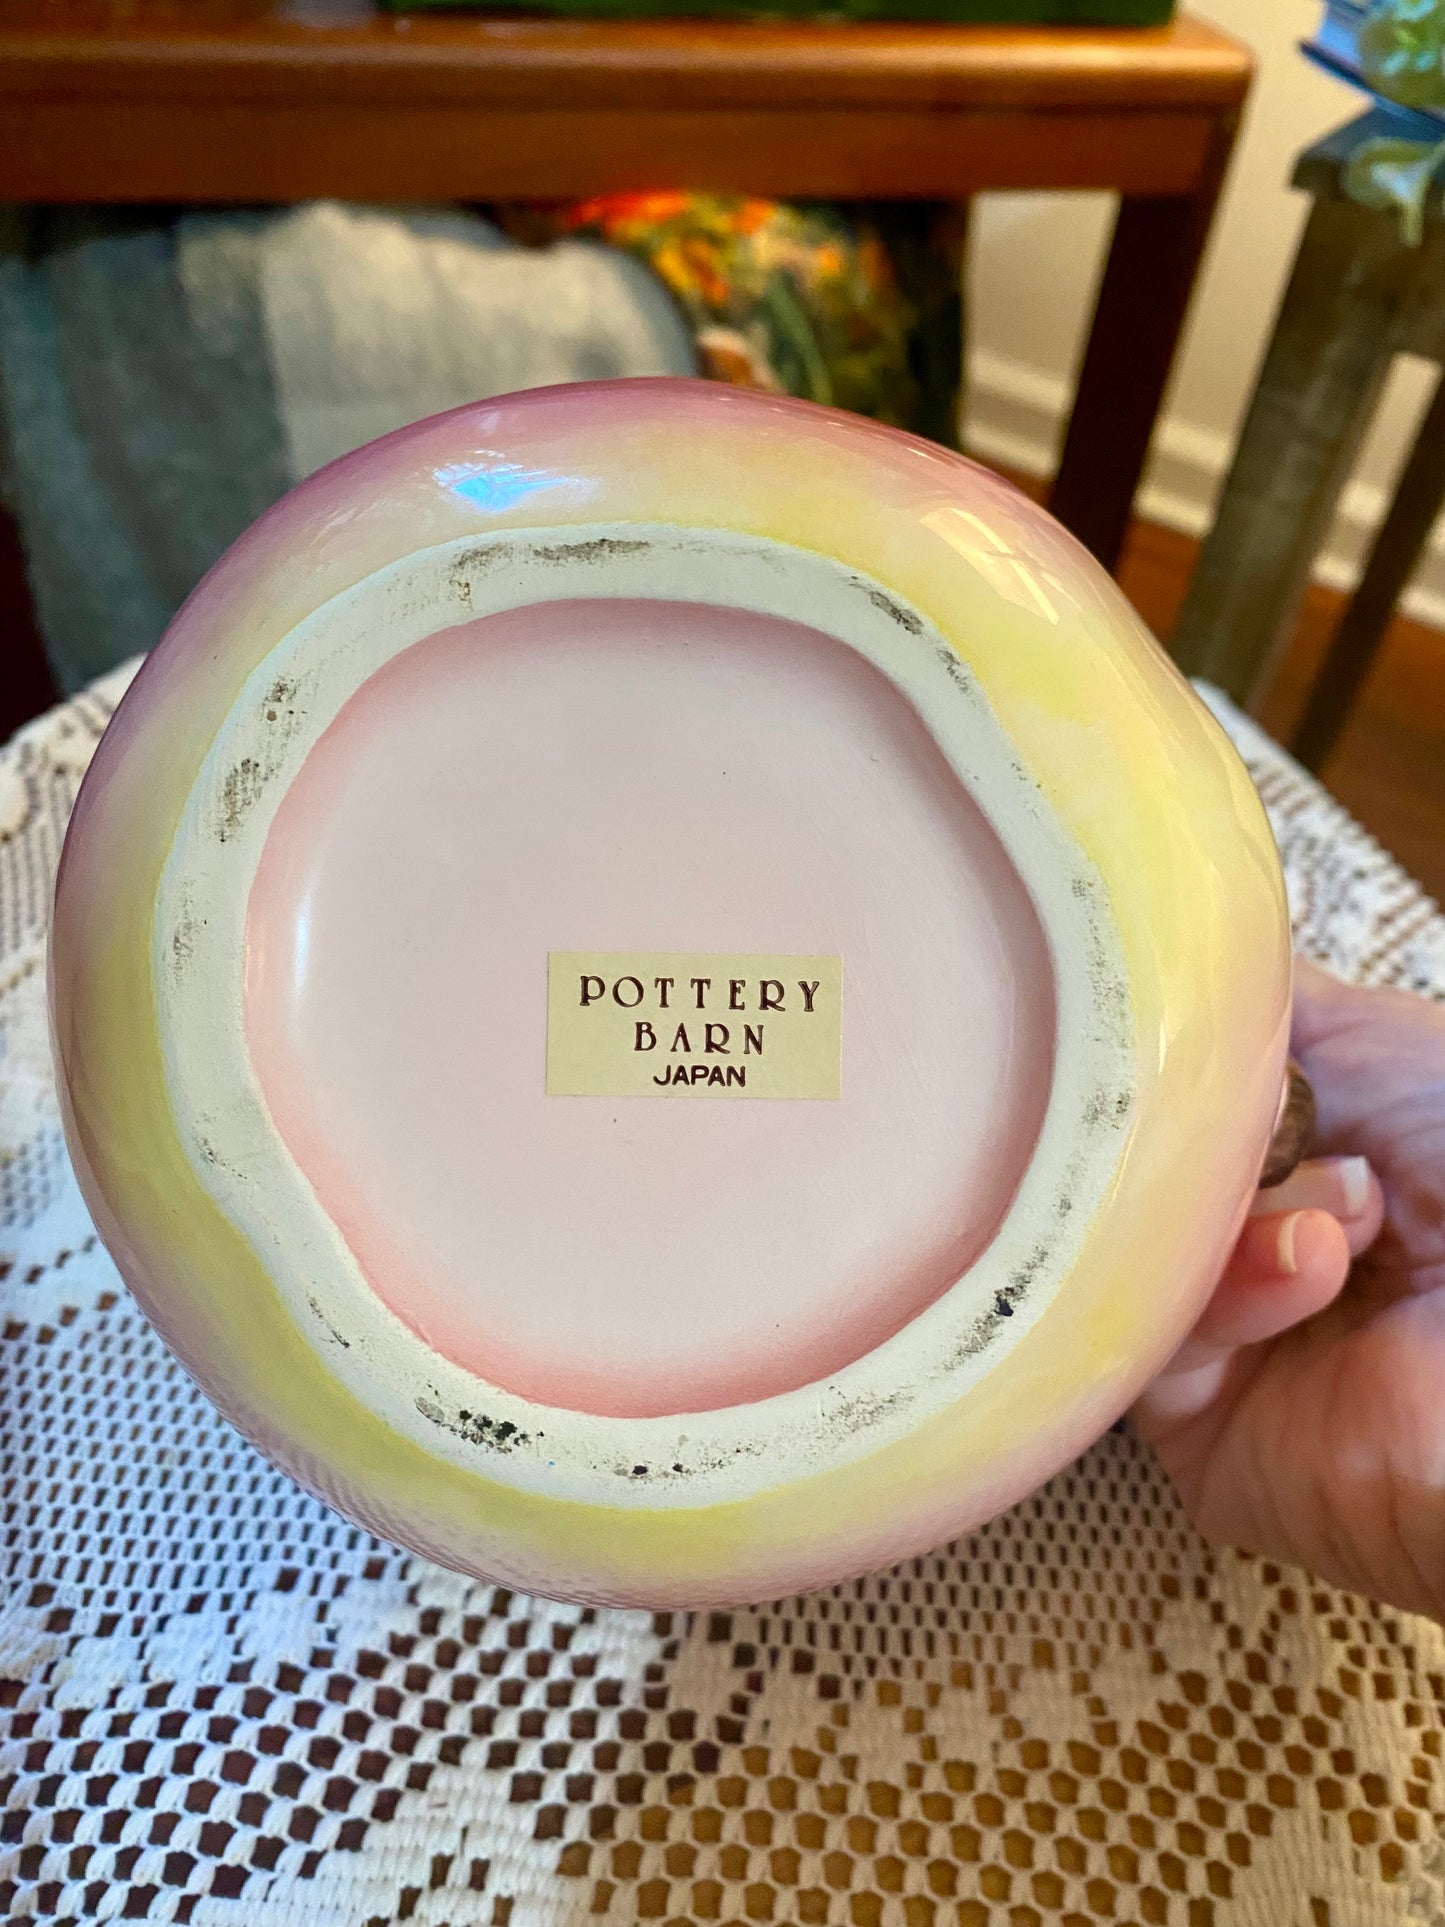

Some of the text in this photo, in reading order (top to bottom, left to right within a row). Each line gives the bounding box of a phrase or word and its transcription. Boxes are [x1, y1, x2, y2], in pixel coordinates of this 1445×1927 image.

[579, 975, 820, 1013] POTTERY
[633, 1021, 765, 1056] BARN
[653, 1064, 746, 1088] JAPAN
